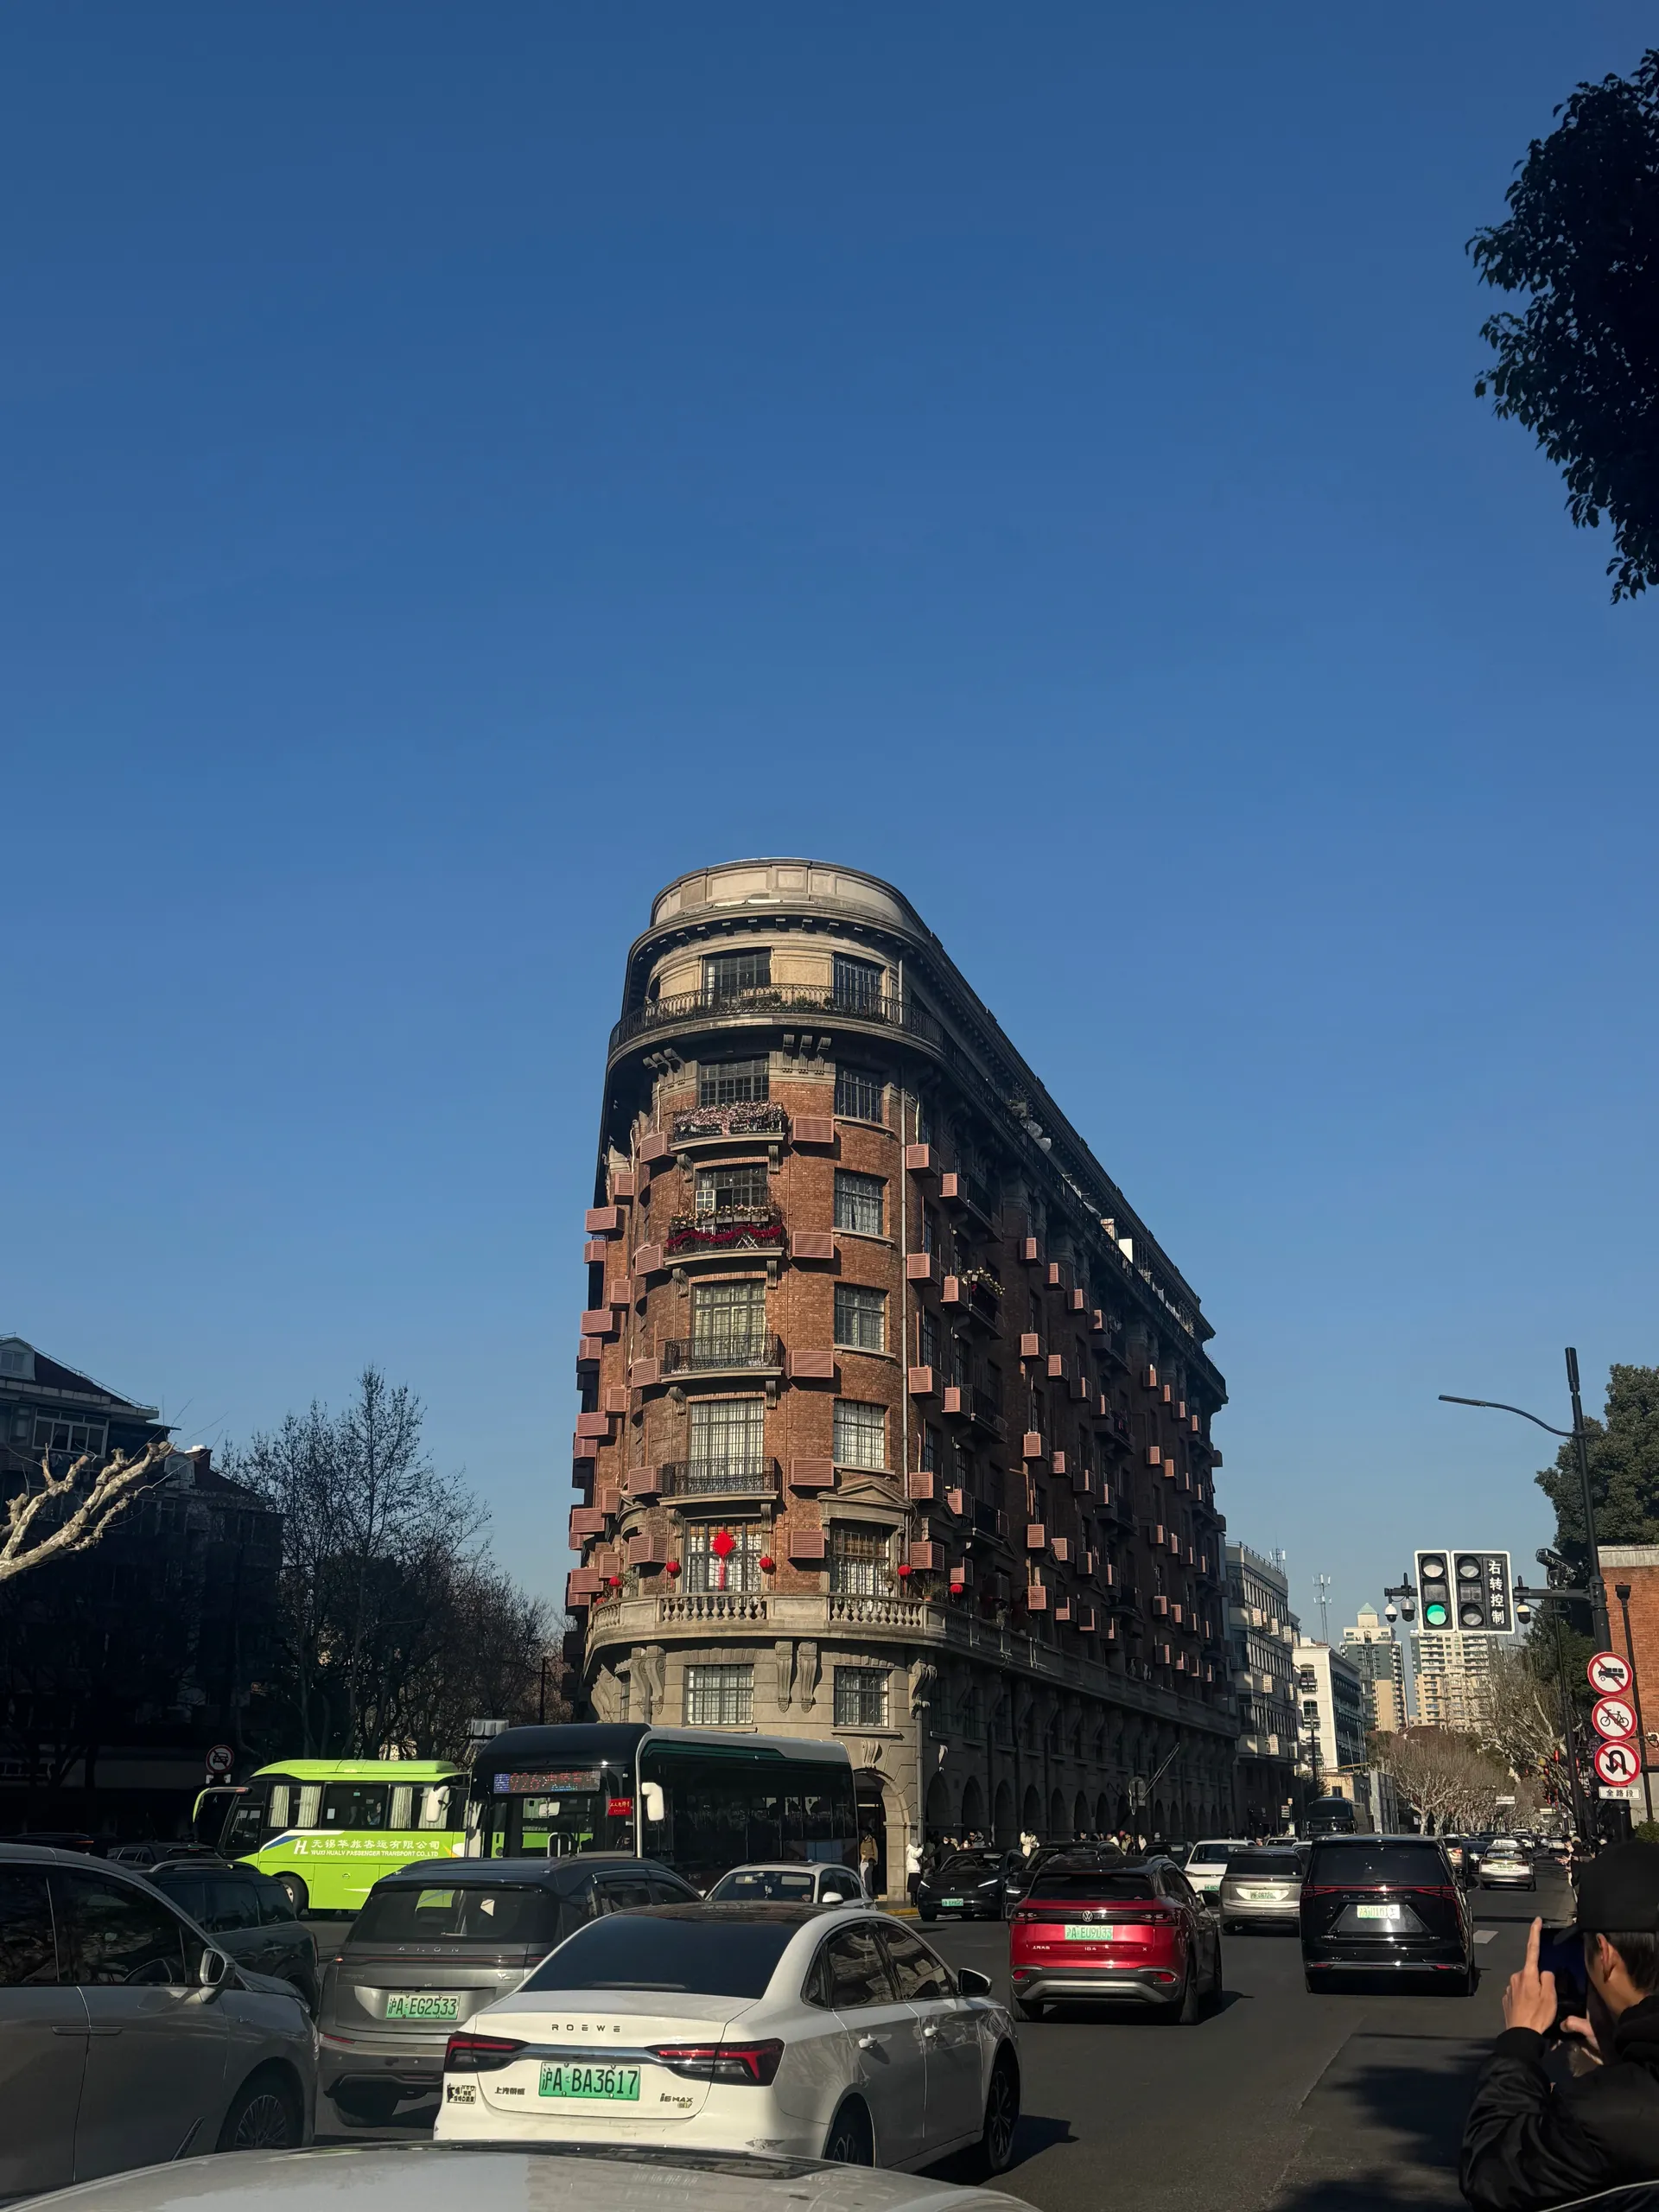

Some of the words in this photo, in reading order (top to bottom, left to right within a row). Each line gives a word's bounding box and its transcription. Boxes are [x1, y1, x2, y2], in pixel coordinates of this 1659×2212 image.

[1488, 1559, 1505, 1625] 右转控制
[1606, 1789, 1634, 1797] 全路段
[311, 1839, 440, 1850] 无锡华旅客运有限公司
[551, 2024, 620, 2033] ROEWE
